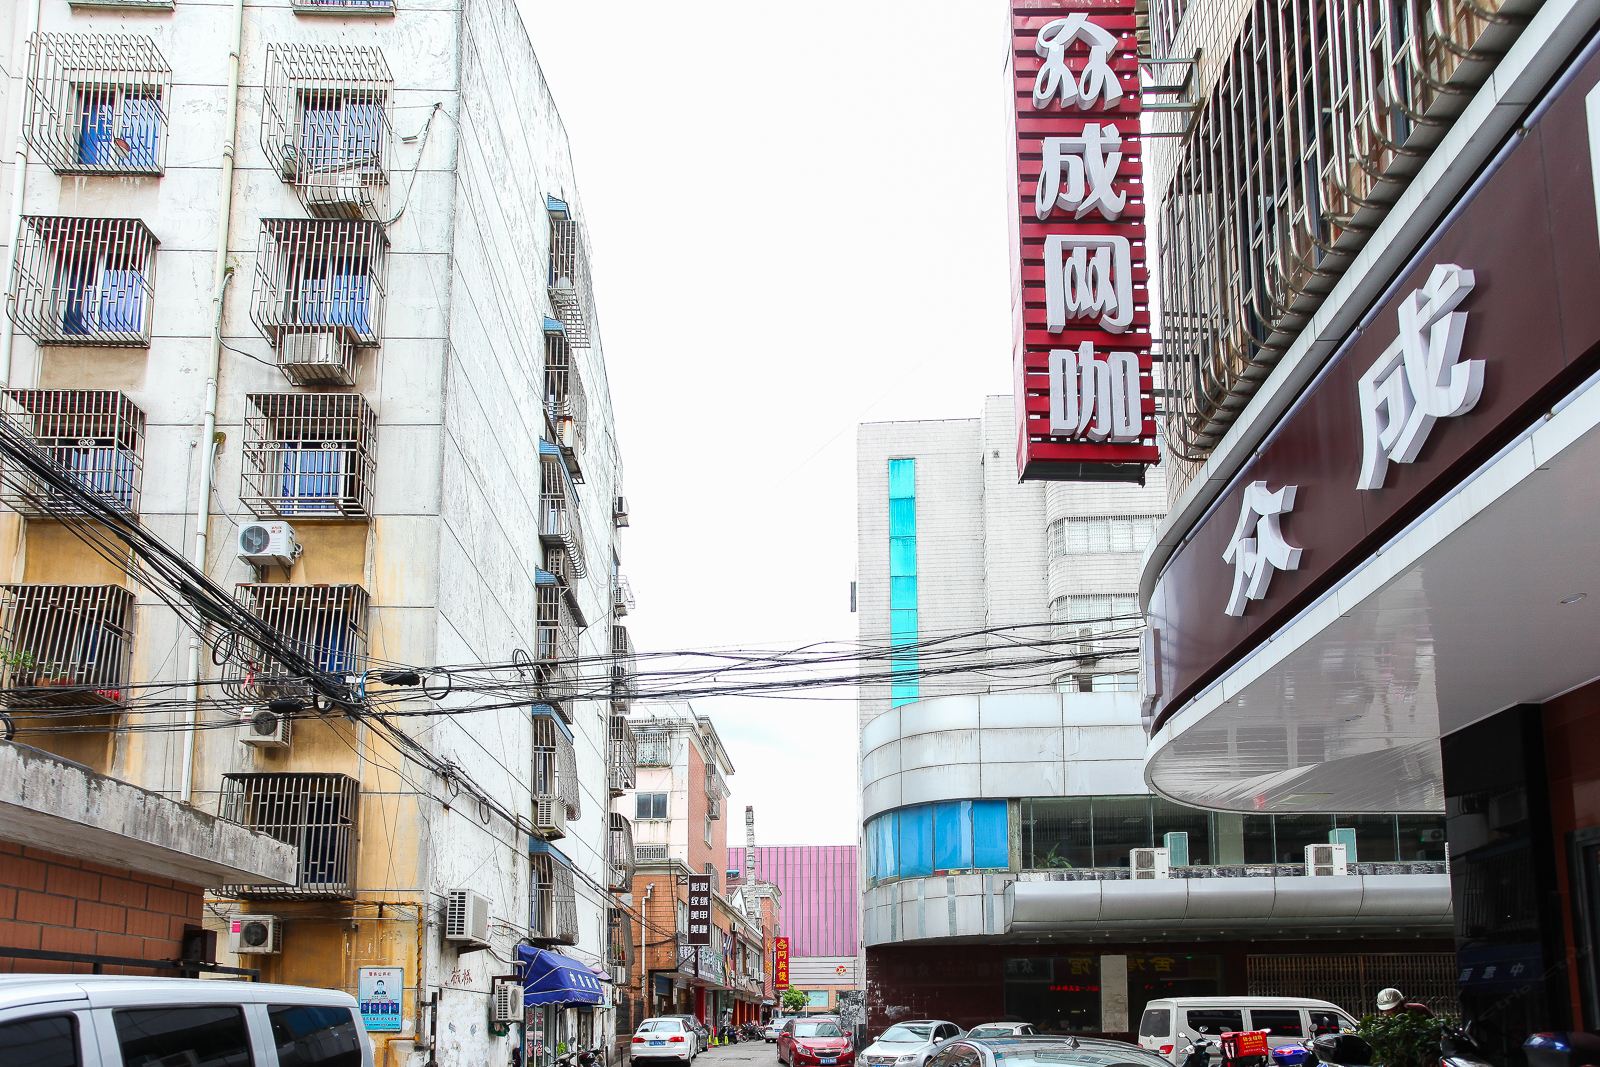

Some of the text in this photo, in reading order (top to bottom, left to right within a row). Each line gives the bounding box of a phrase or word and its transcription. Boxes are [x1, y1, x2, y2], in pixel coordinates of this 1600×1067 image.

[1032, 12, 1143, 443] 众成网咖
[690, 896, 709, 906] 纹绣
[690, 910, 708, 920] 美甲
